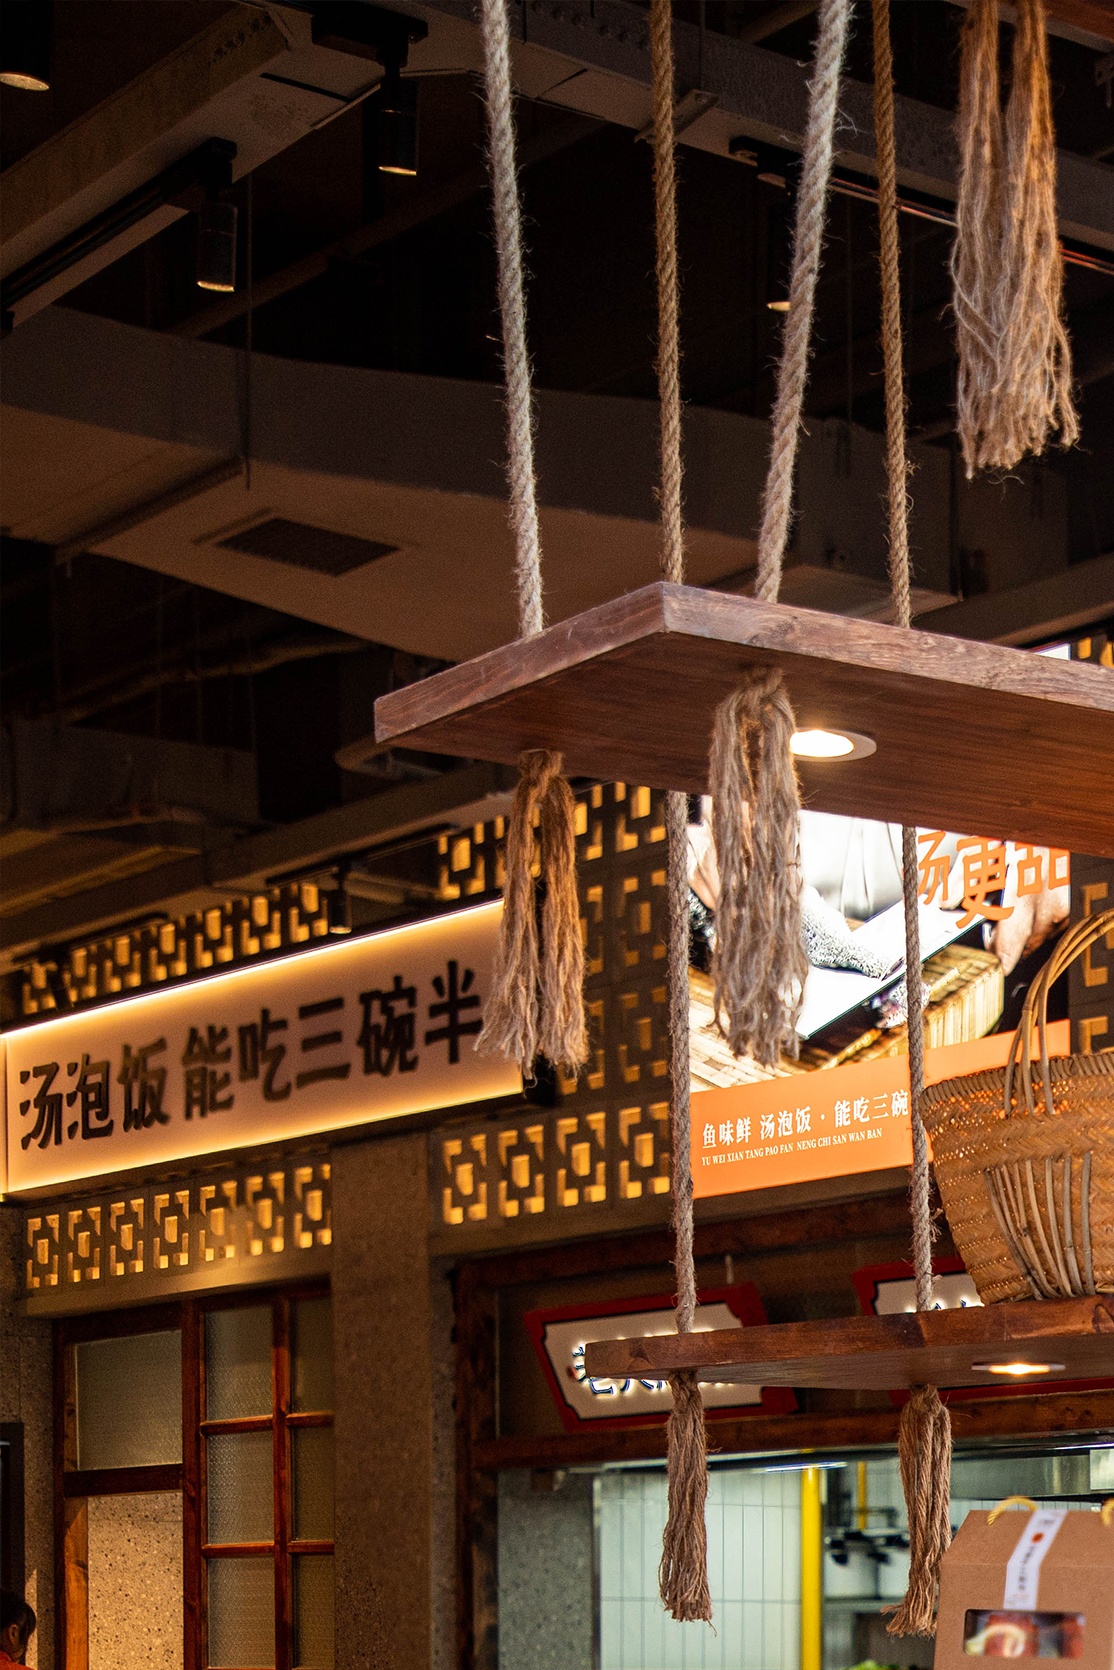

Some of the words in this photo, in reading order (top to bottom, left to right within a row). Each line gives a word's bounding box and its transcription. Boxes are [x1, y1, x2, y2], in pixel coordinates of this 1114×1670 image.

[19, 960, 484, 1151] 汤泡饭能吃三碗半
[702, 1117, 751, 1148] 鱼味鲜
[702, 1155, 711, 1166] YU
[712, 1153, 726, 1164] WEI
[727, 1150, 744, 1163] XIAN
[745, 1148, 764, 1159] TANG
[766, 1145, 778, 1156] PAO
[780, 1143, 793, 1153] FAN
[796, 1139, 817, 1150] NENG
[818, 1137, 831, 1147] CHI
[833, 1134, 847, 1145] SAN
[849, 1131, 865, 1142] WAN
[867, 1128, 882, 1139] BAN
